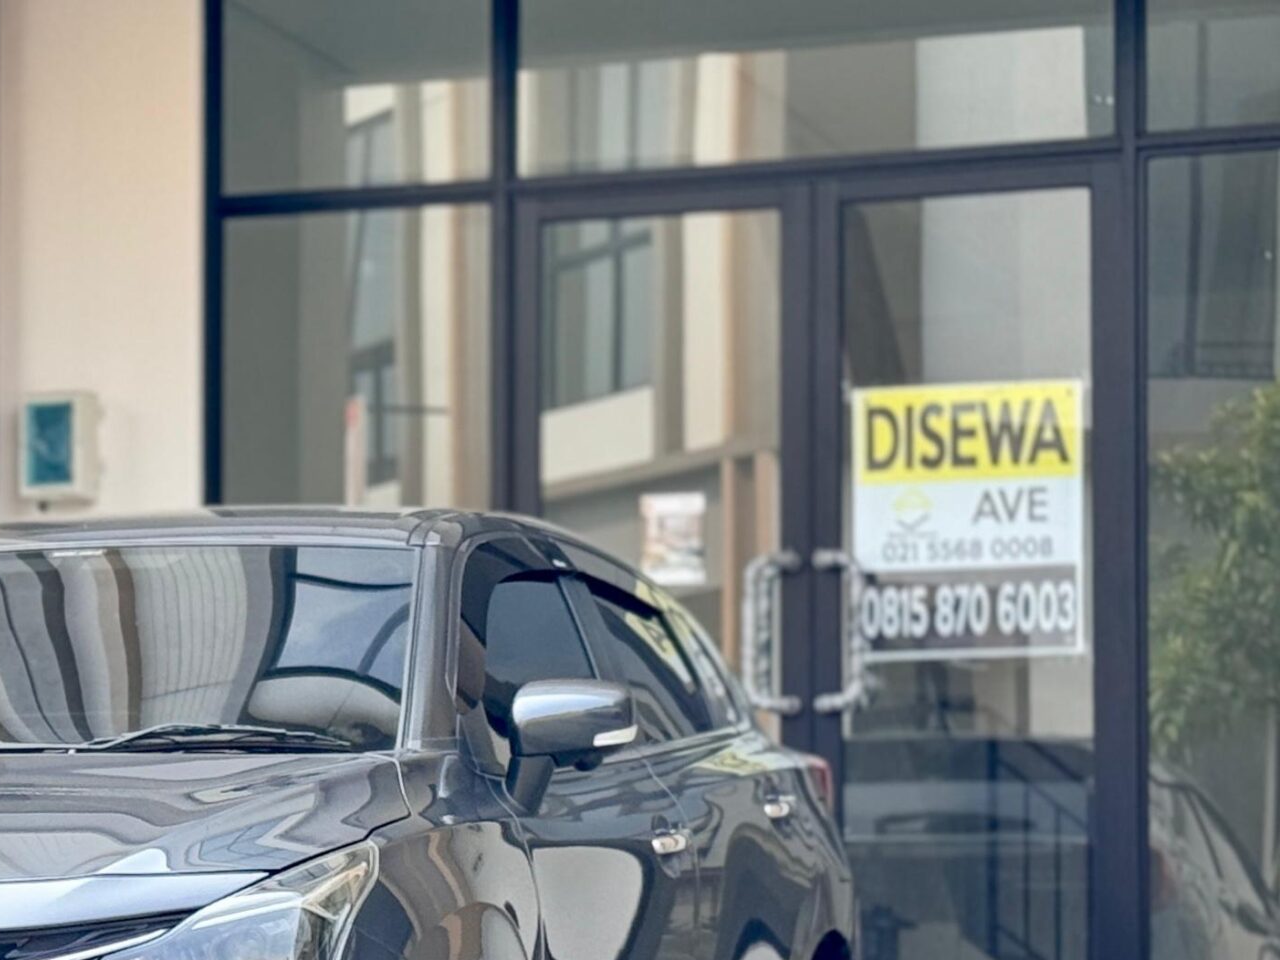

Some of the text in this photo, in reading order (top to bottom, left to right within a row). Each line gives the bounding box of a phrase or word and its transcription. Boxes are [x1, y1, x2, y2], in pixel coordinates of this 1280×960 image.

[866, 399, 1070, 471] DISEWA
[972, 486, 1048, 524] AVE
[881, 539, 918, 563] 021
[990, 535, 1054, 558] 0008
[860, 578, 1076, 639] 0815 870 6003
